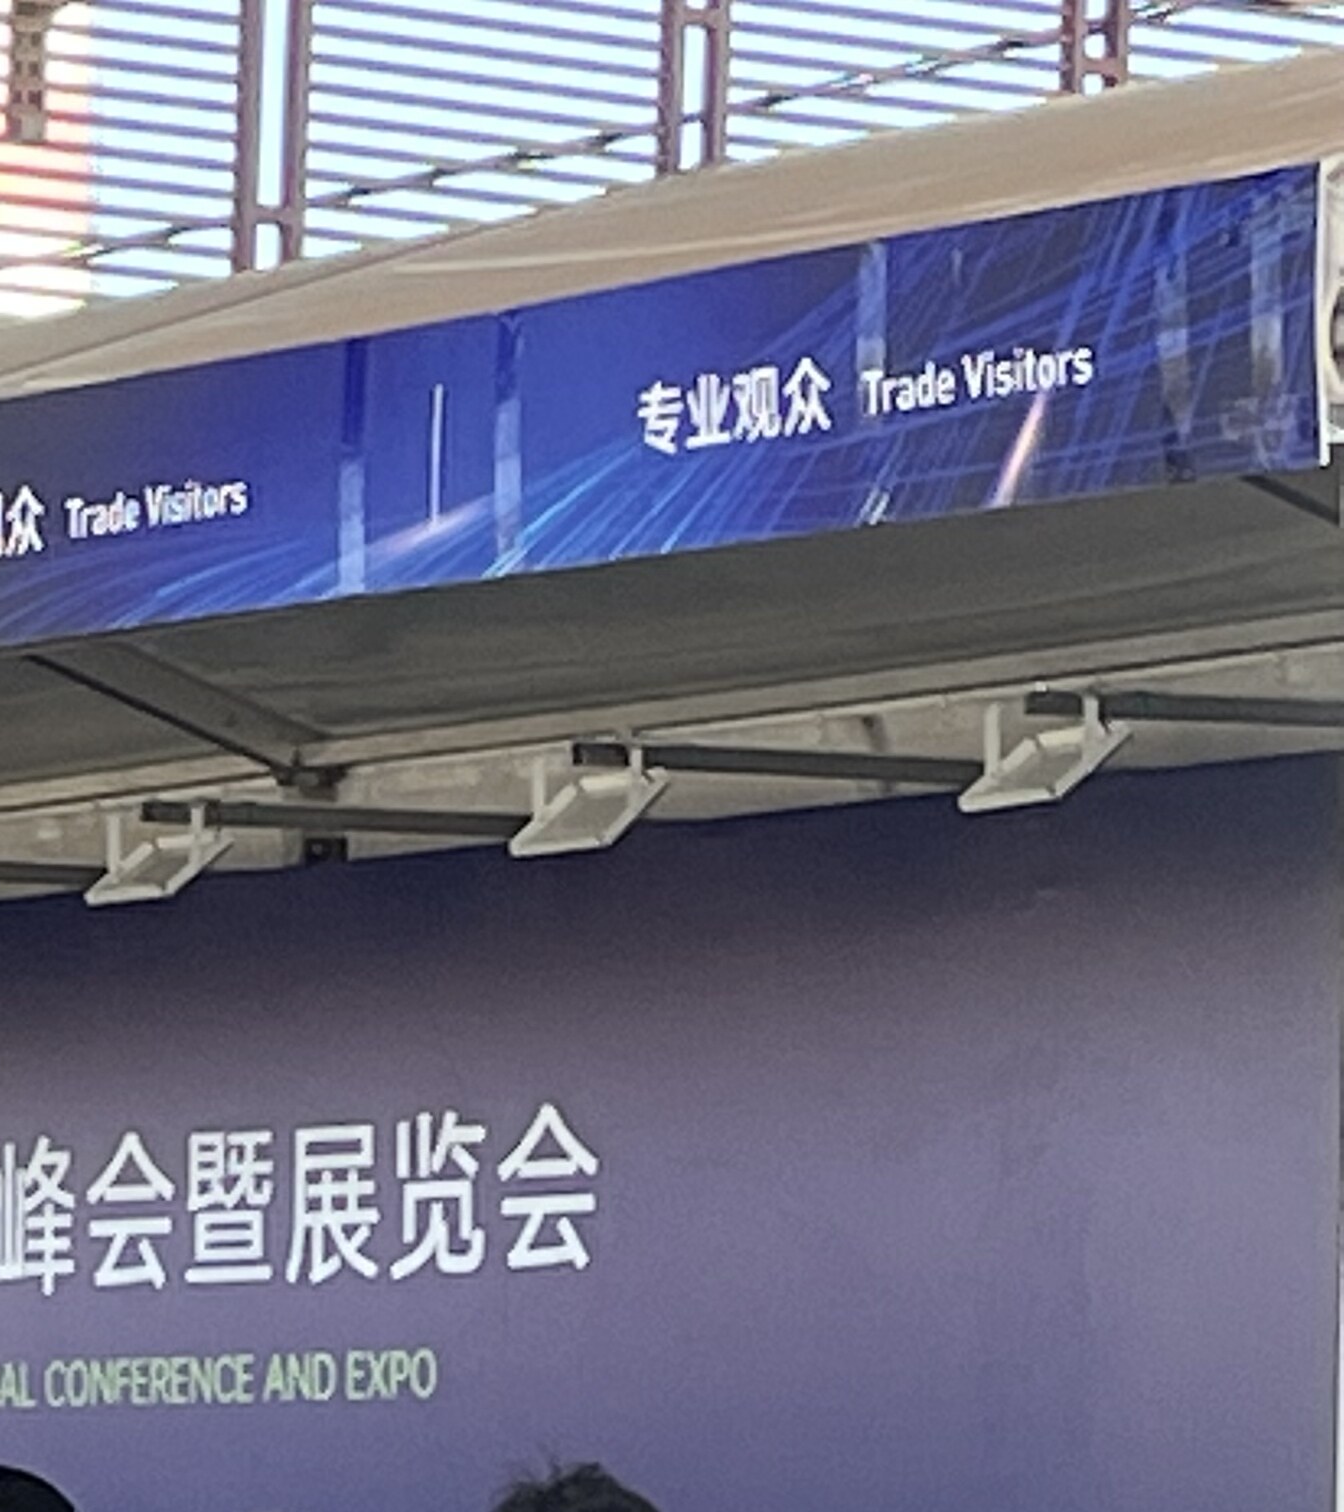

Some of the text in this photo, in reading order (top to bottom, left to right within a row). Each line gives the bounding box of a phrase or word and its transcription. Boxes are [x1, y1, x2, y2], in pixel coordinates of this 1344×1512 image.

[637, 347, 1092, 454] 专业观众 Trade Visitors
[64, 492, 139, 538] Trade
[144, 479, 247, 527] Visitors
[44, 1354, 255, 1408] CONFERENCE
[263, 1352, 338, 1402] AND
[344, 1347, 437, 1400] EXPO
